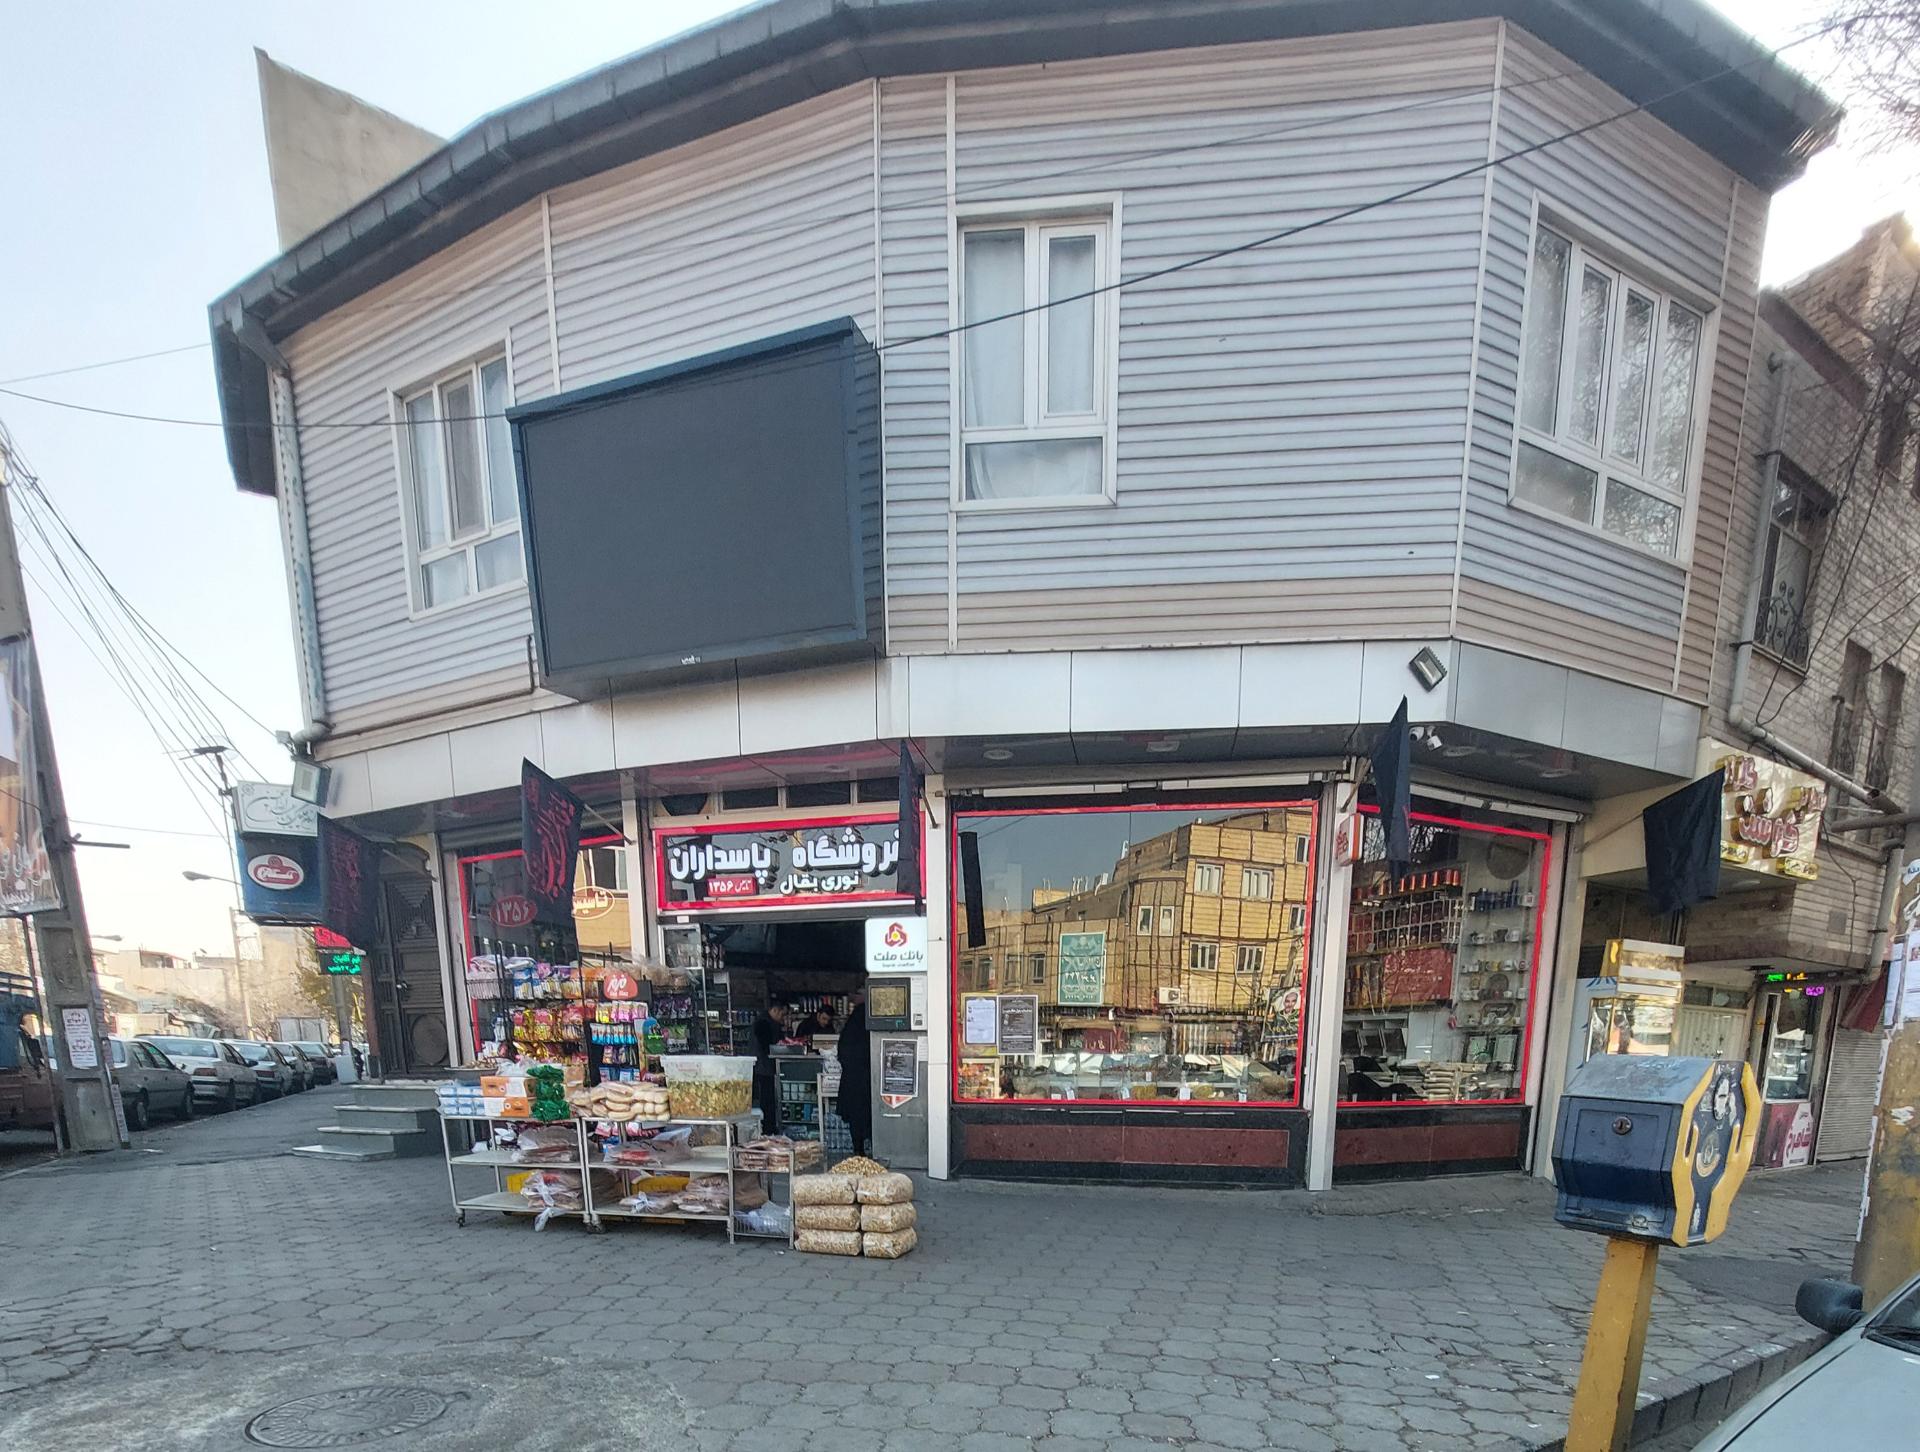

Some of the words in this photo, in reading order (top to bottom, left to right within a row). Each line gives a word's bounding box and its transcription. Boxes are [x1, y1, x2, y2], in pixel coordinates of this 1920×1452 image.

[669, 842, 771, 884] پاسداران
[708, 880, 734, 894] ۱۳۵۶
[779, 873, 818, 895] بقال
[820, 870, 859, 892] نوری
[496, 901, 529, 922] ۱۳۵۶
[874, 951, 897, 961] ملت
[900, 950, 923, 963] بانک
